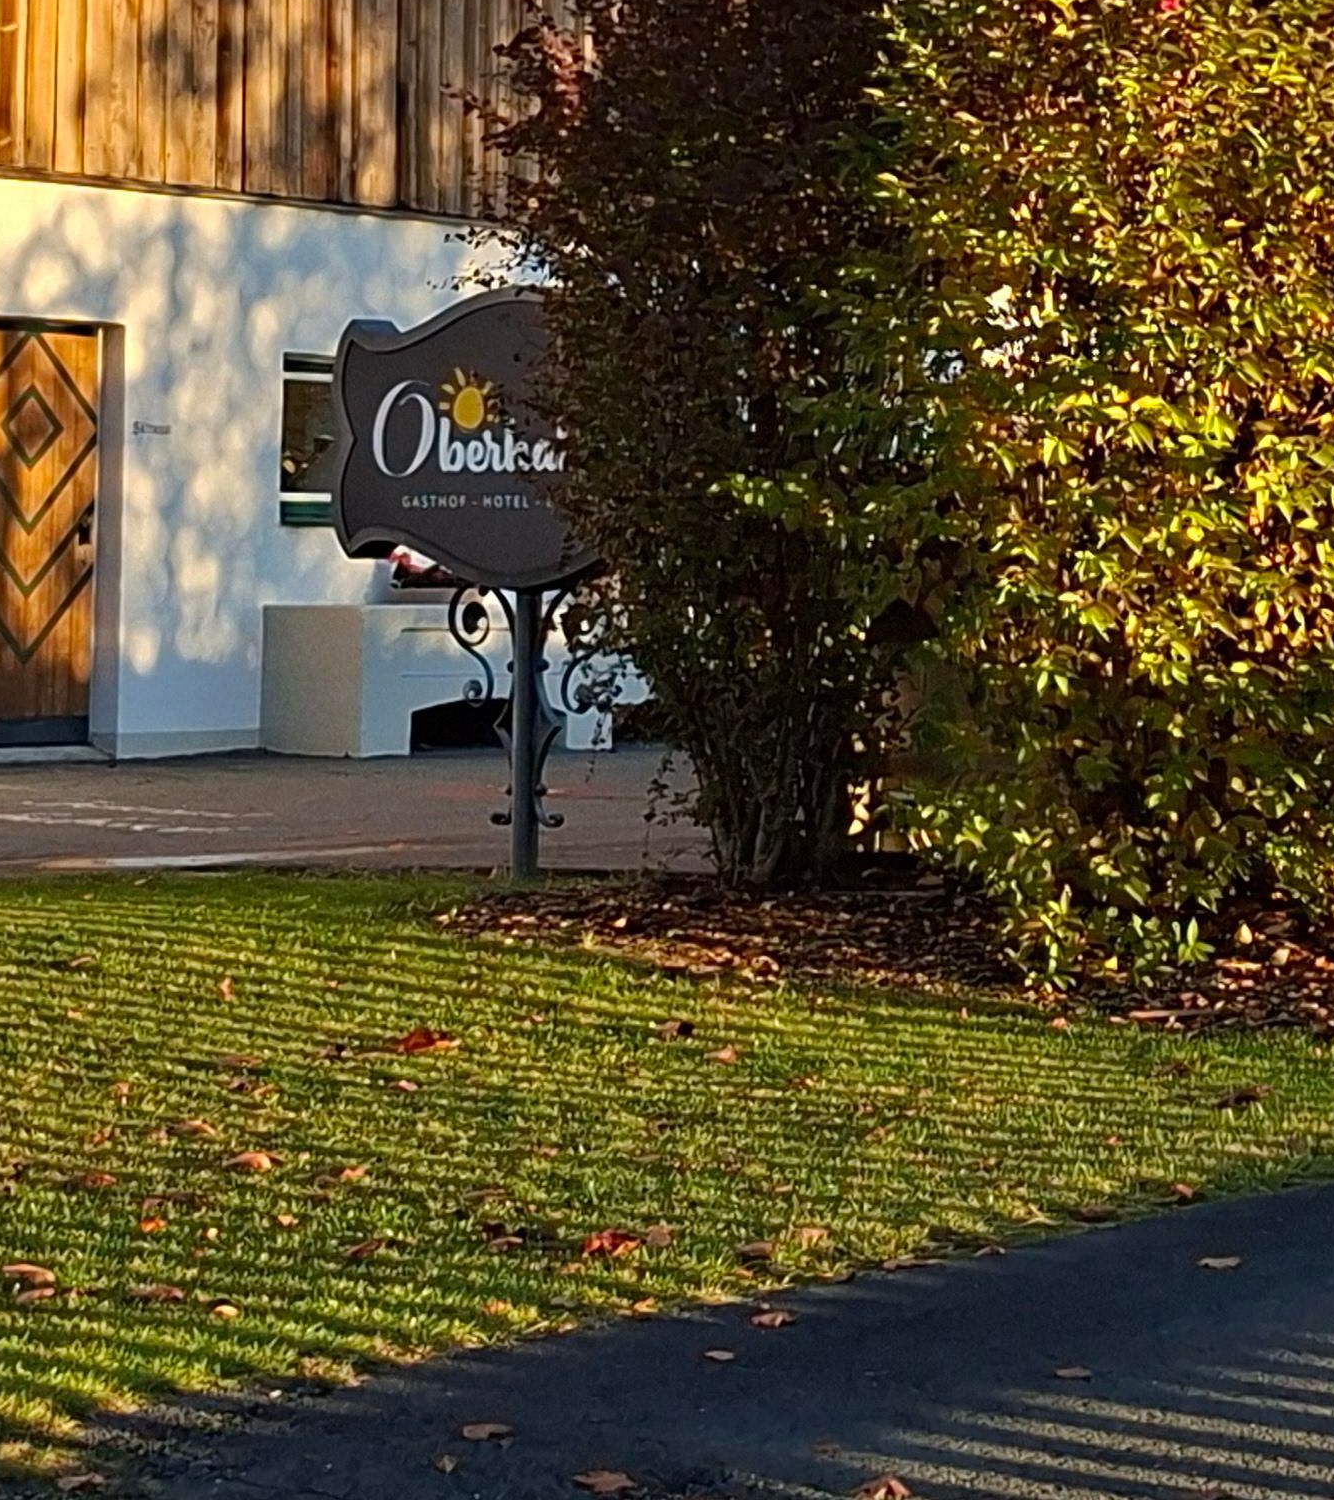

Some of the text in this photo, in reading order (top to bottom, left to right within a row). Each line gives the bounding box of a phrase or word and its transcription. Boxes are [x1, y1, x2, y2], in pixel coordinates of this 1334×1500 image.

[373, 379, 567, 477] Oberha
[402, 494, 466, 509] GASTHOF
[482, 494, 530, 509] HOTEL
